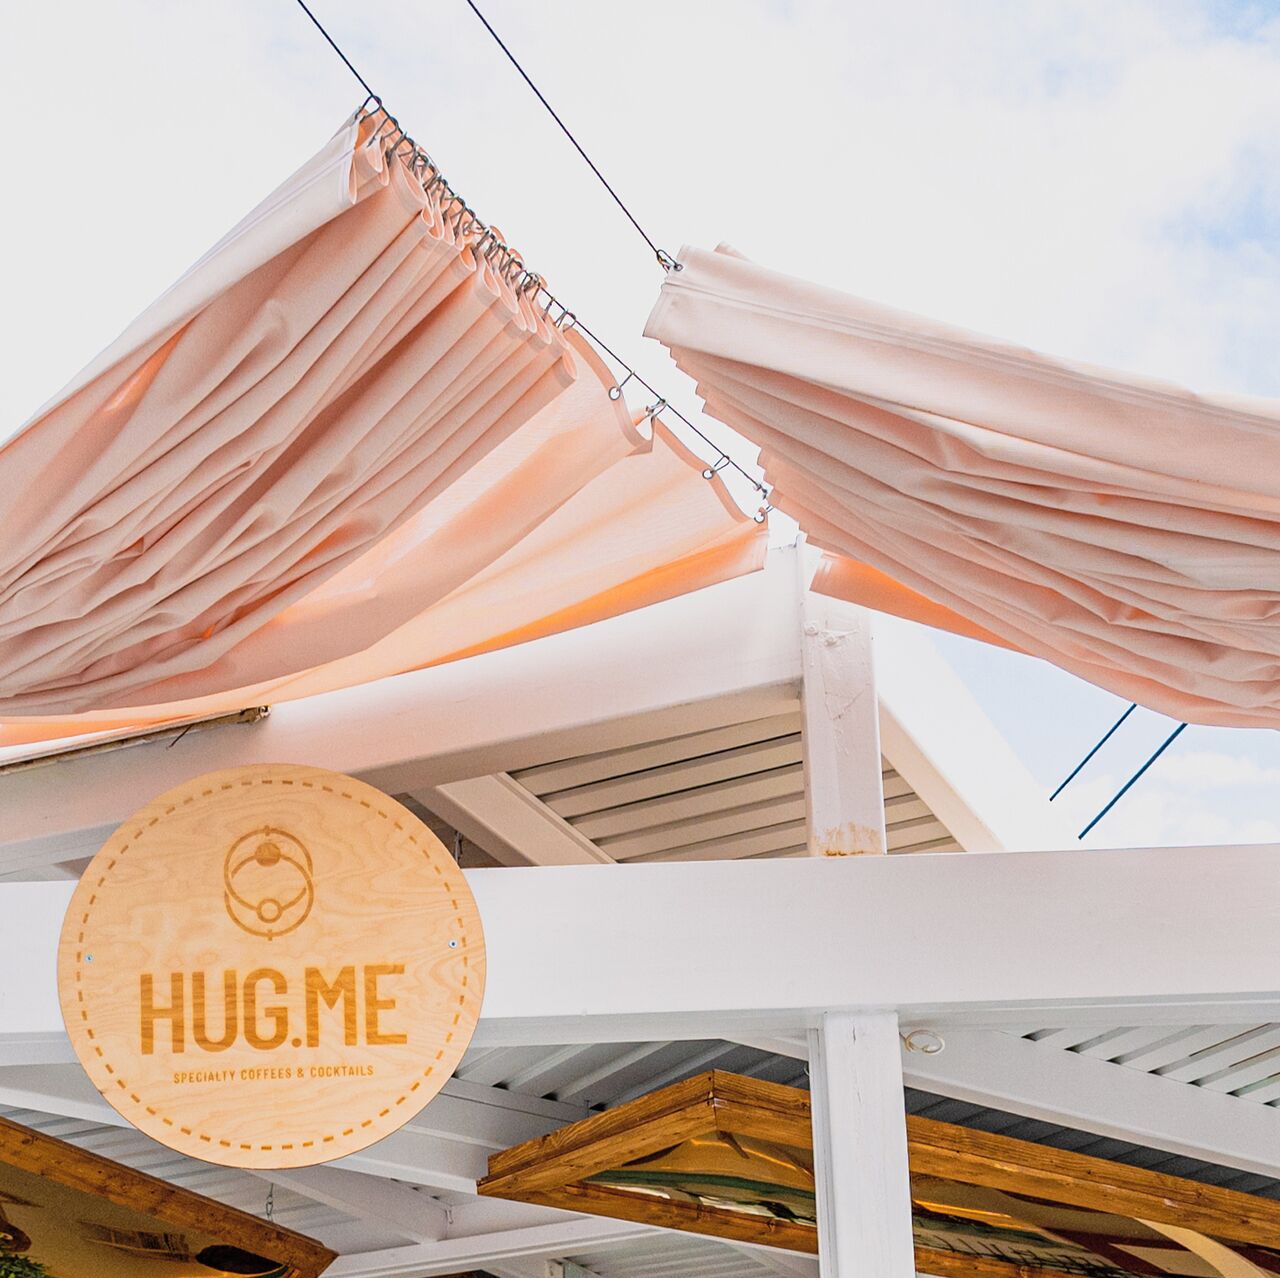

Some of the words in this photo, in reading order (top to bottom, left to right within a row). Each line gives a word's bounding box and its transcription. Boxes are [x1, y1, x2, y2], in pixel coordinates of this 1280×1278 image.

[139, 963, 408, 1055] HUG.ME
[173, 1070, 236, 1084] SPECIALTY
[240, 1067, 292, 1081] COFFEES
[296, 1067, 305, 1078] &
[310, 1065, 374, 1078] COCKTAILS
